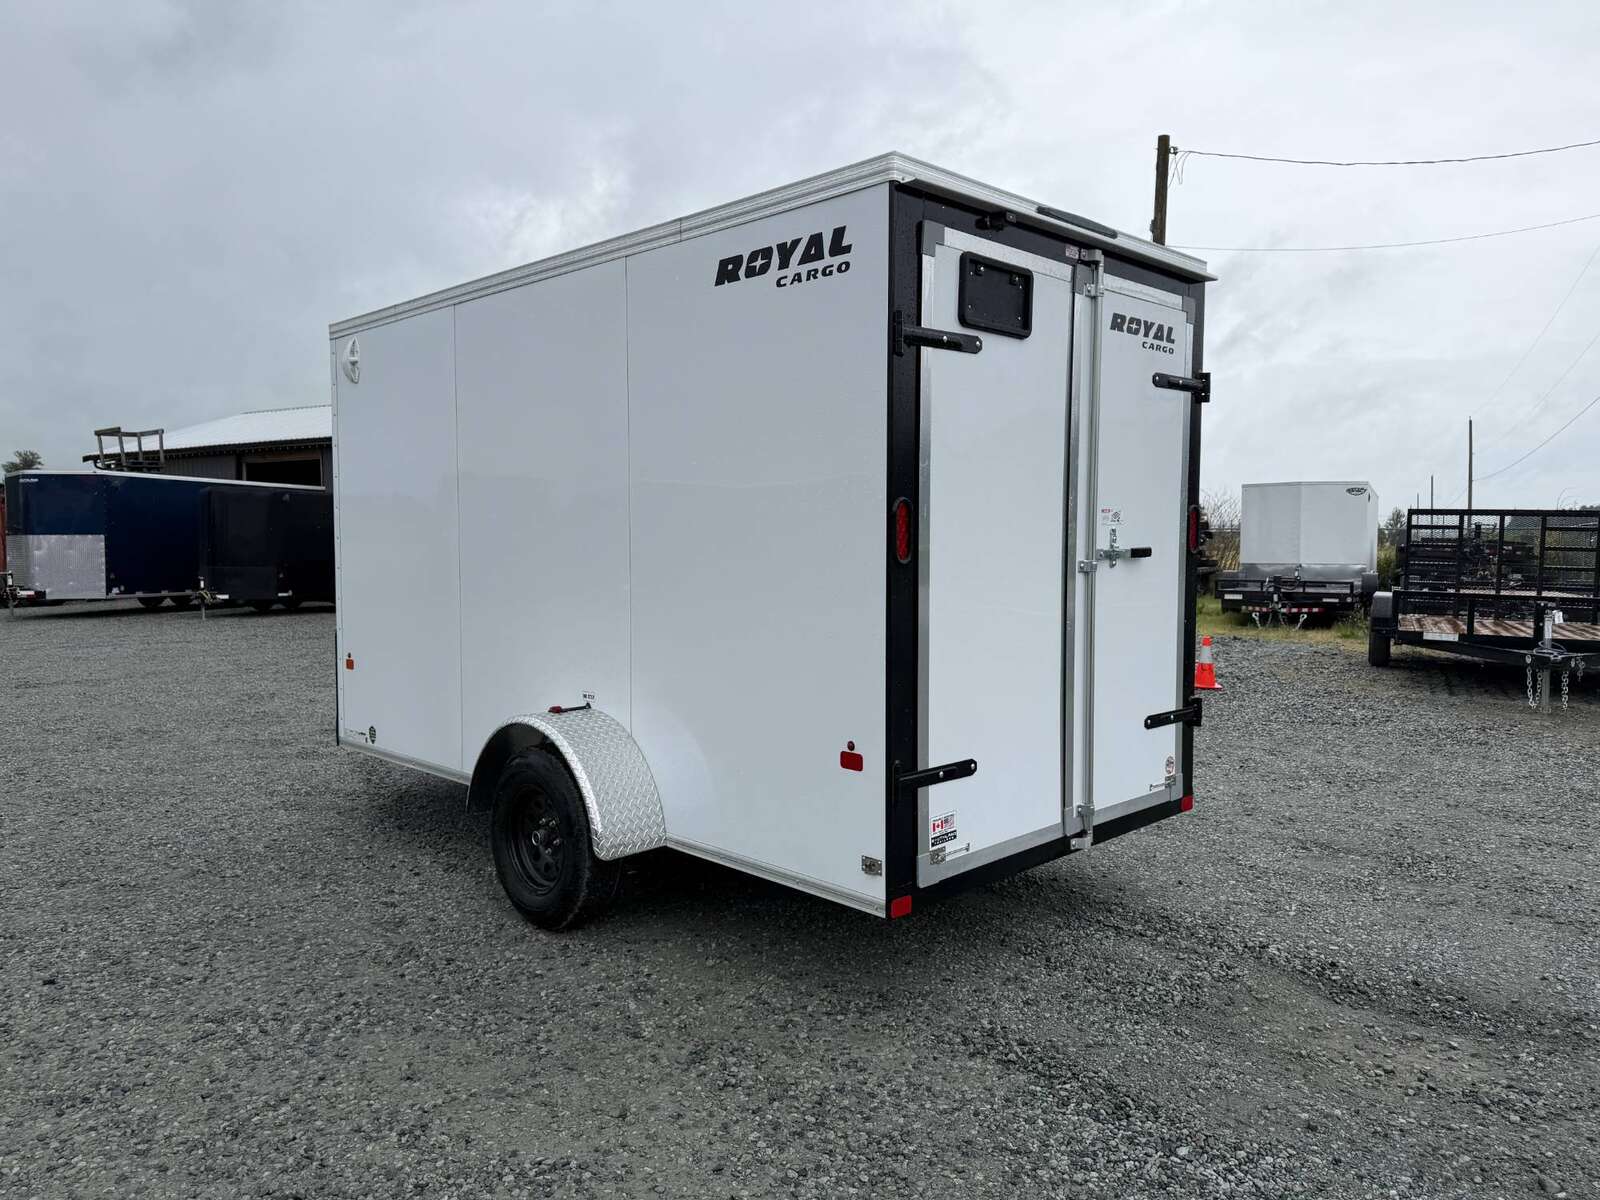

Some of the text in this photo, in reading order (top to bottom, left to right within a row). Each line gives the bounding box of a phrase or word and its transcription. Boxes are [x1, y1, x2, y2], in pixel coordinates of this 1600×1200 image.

[714, 225, 852, 287] ROYAL
[776, 261, 851, 287] CARGO
[1110, 312, 1175, 344] ROYAL
[1142, 341, 1174, 354] CARGO
